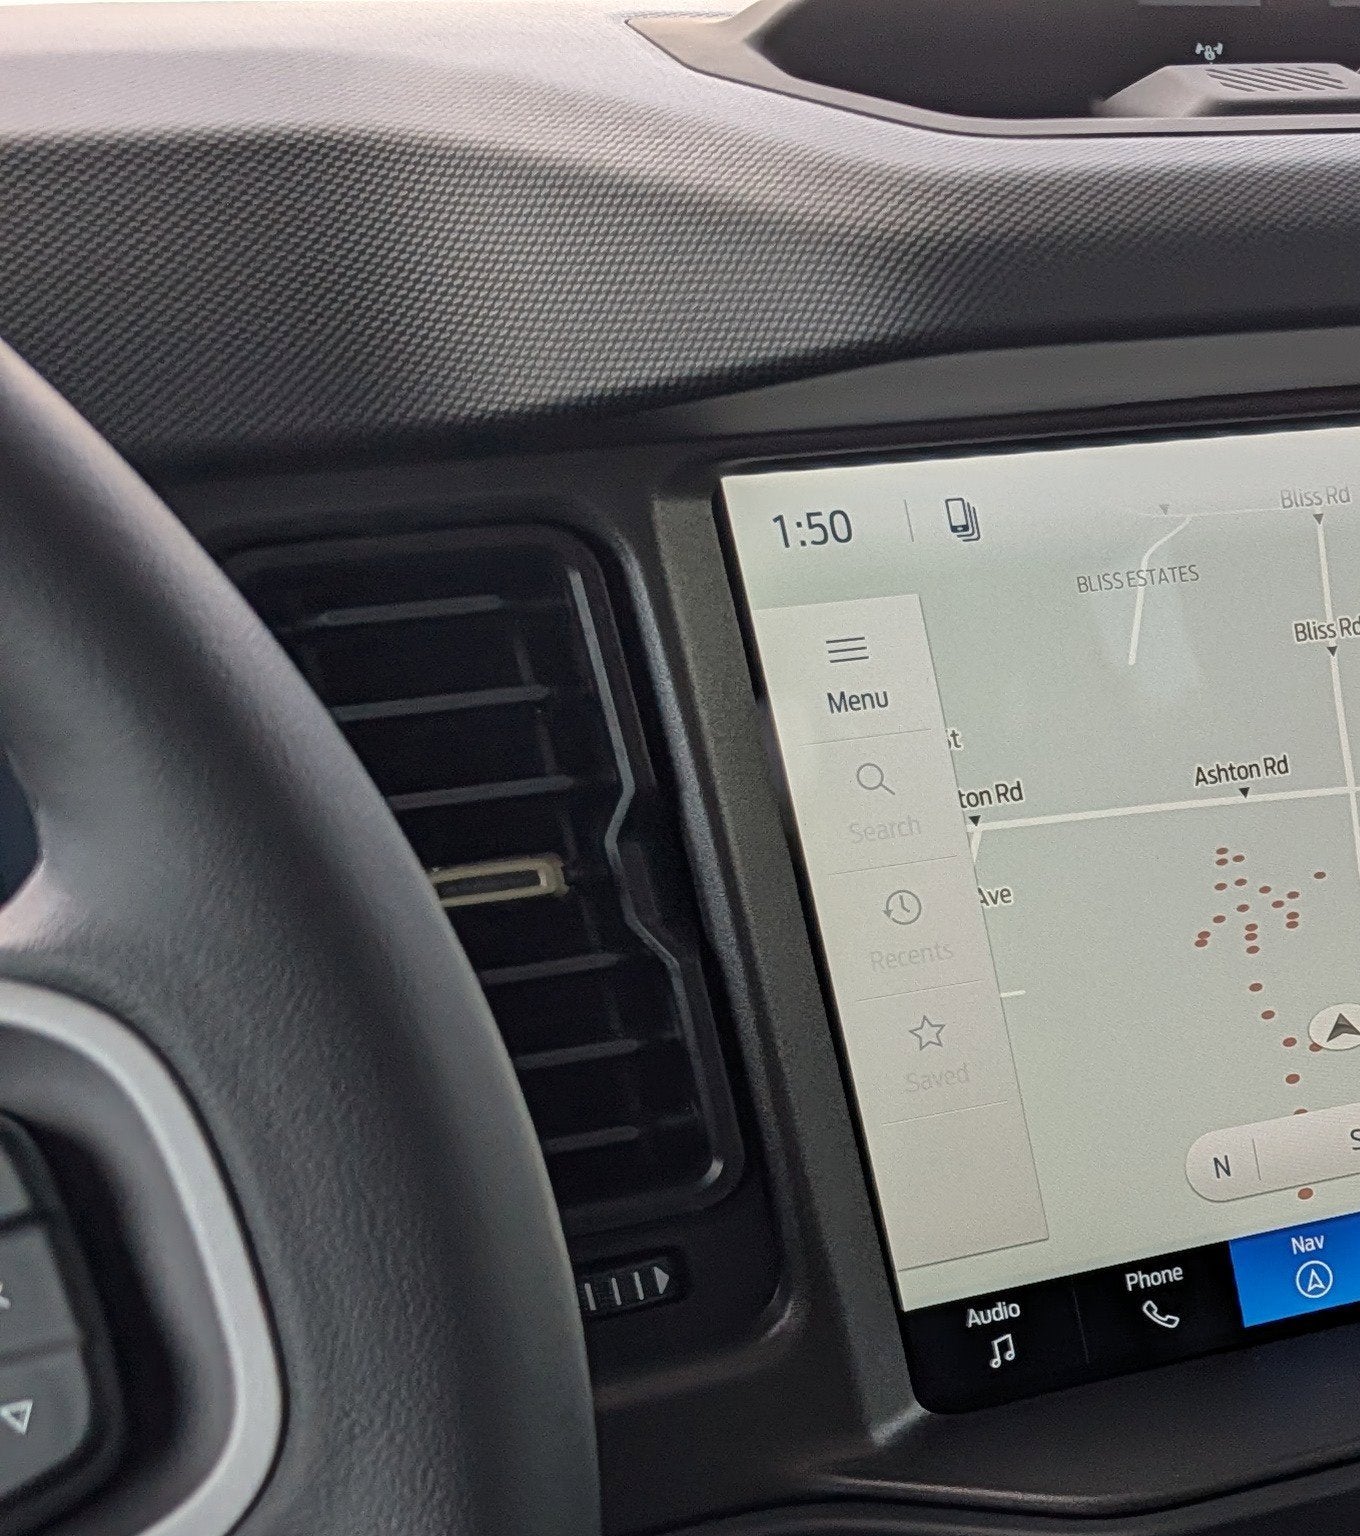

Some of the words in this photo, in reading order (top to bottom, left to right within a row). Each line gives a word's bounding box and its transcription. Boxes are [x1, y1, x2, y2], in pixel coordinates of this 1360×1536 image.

[1279, 488, 1322, 510] Bliss
[1325, 486, 1351, 505] Rd
[772, 508, 853, 549] 1:50
[1076, 570, 1124, 594] BLISS
[1126, 564, 1200, 589] ESTATES
[1293, 620, 1336, 643] Bliss
[827, 689, 889, 714] Menu
[1194, 759, 1260, 786] Ashton
[1262, 754, 1289, 776] Rd
[958, 789, 992, 809] ton
[995, 780, 1023, 803] Rd
[849, 814, 922, 843] Search
[870, 942, 955, 972] Recents
[904, 1064, 970, 1093] Saved
[1213, 1156, 1231, 1178] N
[1291, 1235, 1324, 1255] Nav
[1125, 1265, 1184, 1292] Phone
[966, 1302, 1021, 1327] Audio
